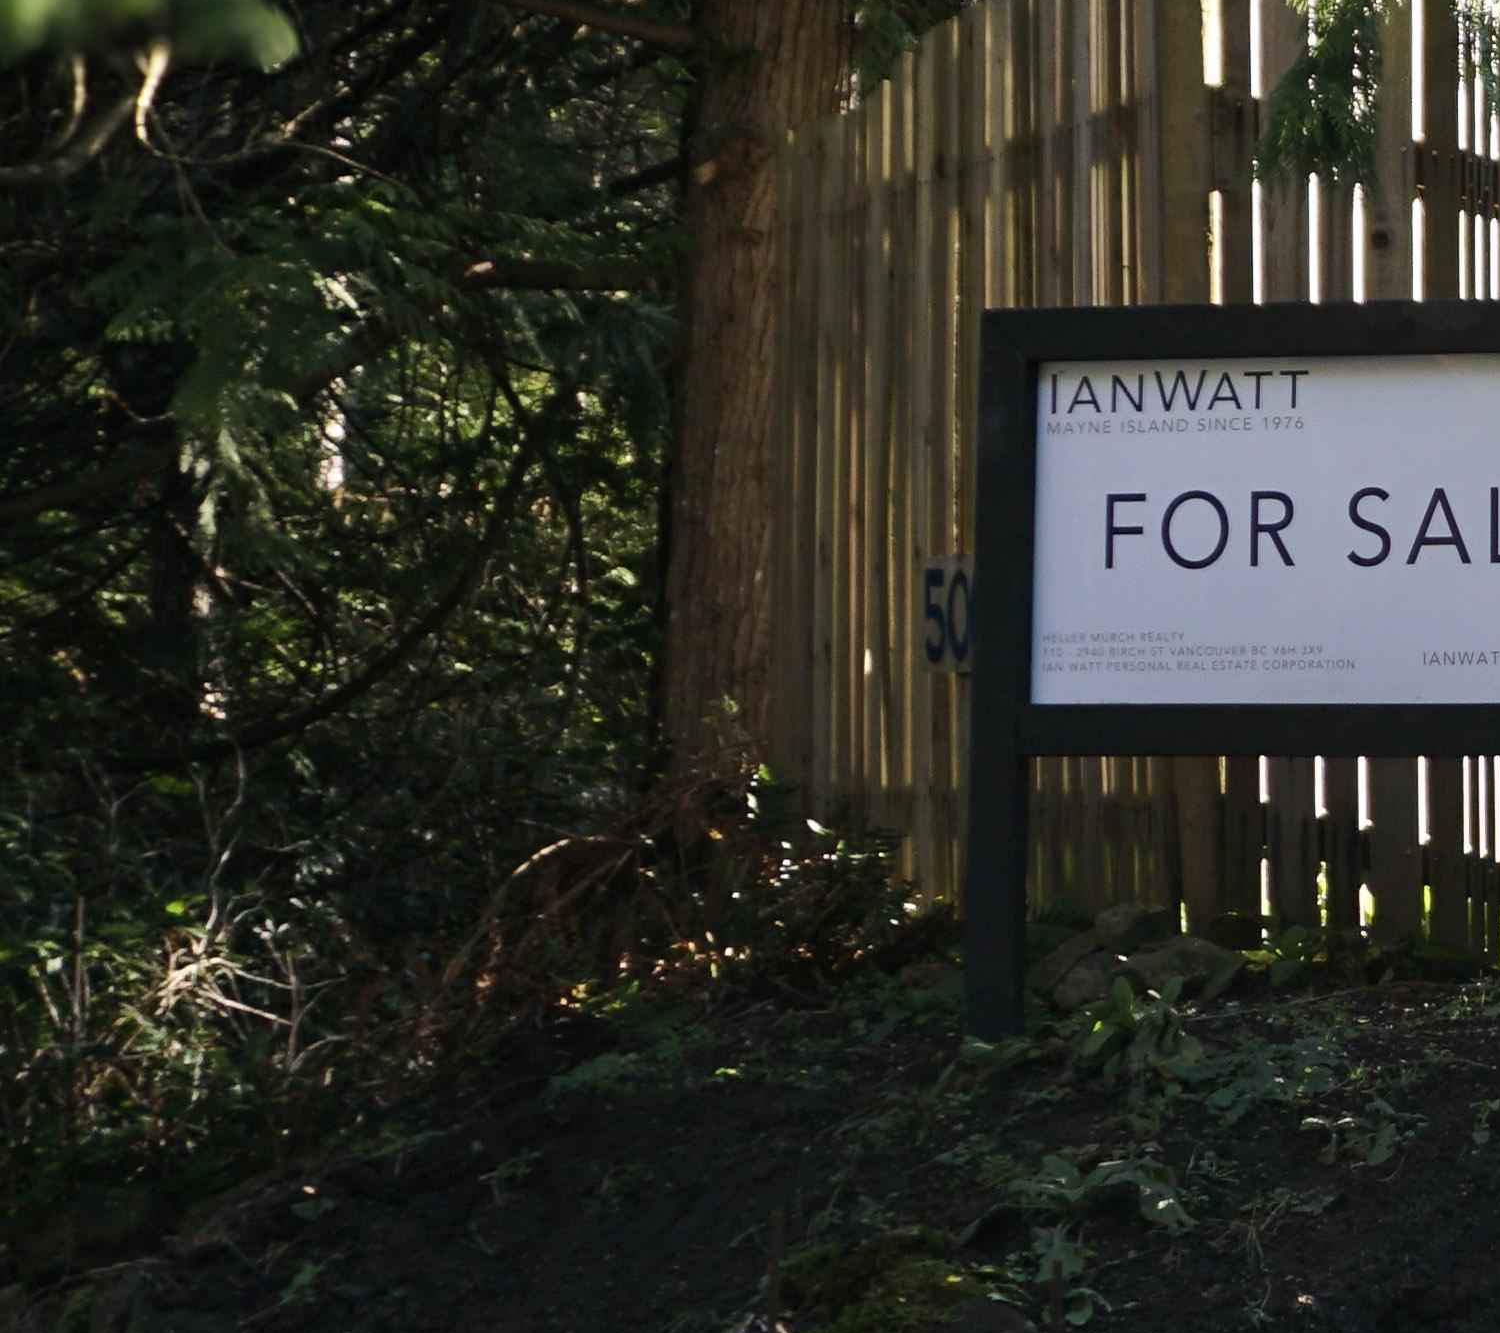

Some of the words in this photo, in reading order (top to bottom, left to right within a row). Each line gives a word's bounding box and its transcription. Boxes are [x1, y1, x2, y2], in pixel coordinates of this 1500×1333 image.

[1051, 369, 1309, 414] IANWATT
[1047, 420, 1111, 435] MAYNE
[1120, 418, 1188, 434] ISLAND
[1197, 417, 1252, 432] SINCE
[1262, 416, 1305, 431] 1976
[1105, 490, 1295, 569] FOR
[1139, 631, 1185, 643] REALTY
[1108, 646, 1146, 658] BIRCH
[1150, 646, 1164, 658] ST
[1168, 645, 1247, 657] VANCOUVER
[1250, 645, 1268, 656] BC
[1068, 661, 1103, 672] WATT
[1107, 660, 1172, 672] PERSONAL
[1176, 660, 1207, 671] REAL
[1211, 659, 1258, 671] ESTATE
[1262, 658, 1357, 670] CORPORATION
